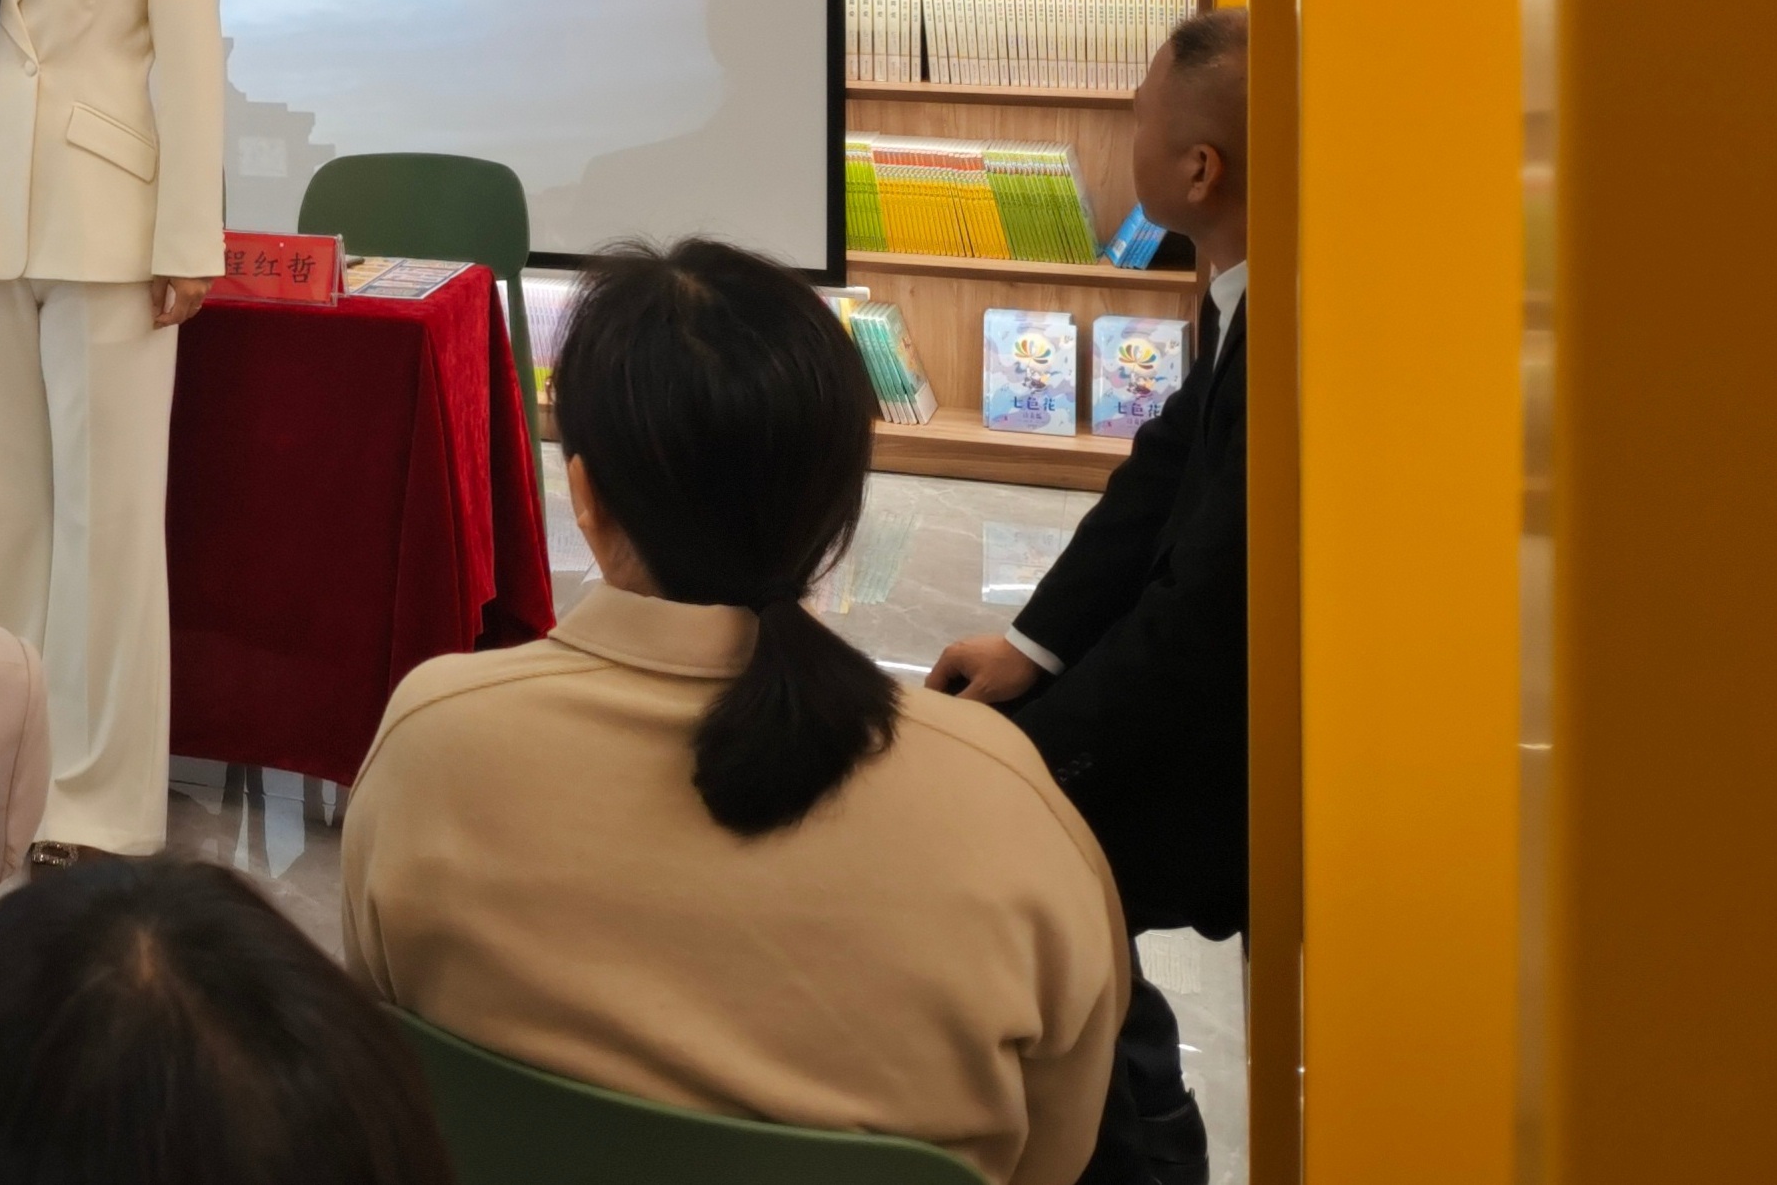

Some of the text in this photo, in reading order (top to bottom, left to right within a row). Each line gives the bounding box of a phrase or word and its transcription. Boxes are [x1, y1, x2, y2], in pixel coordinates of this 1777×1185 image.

[225, 249, 317, 284] 程红哲
[1012, 396, 1056, 412] 七色花
